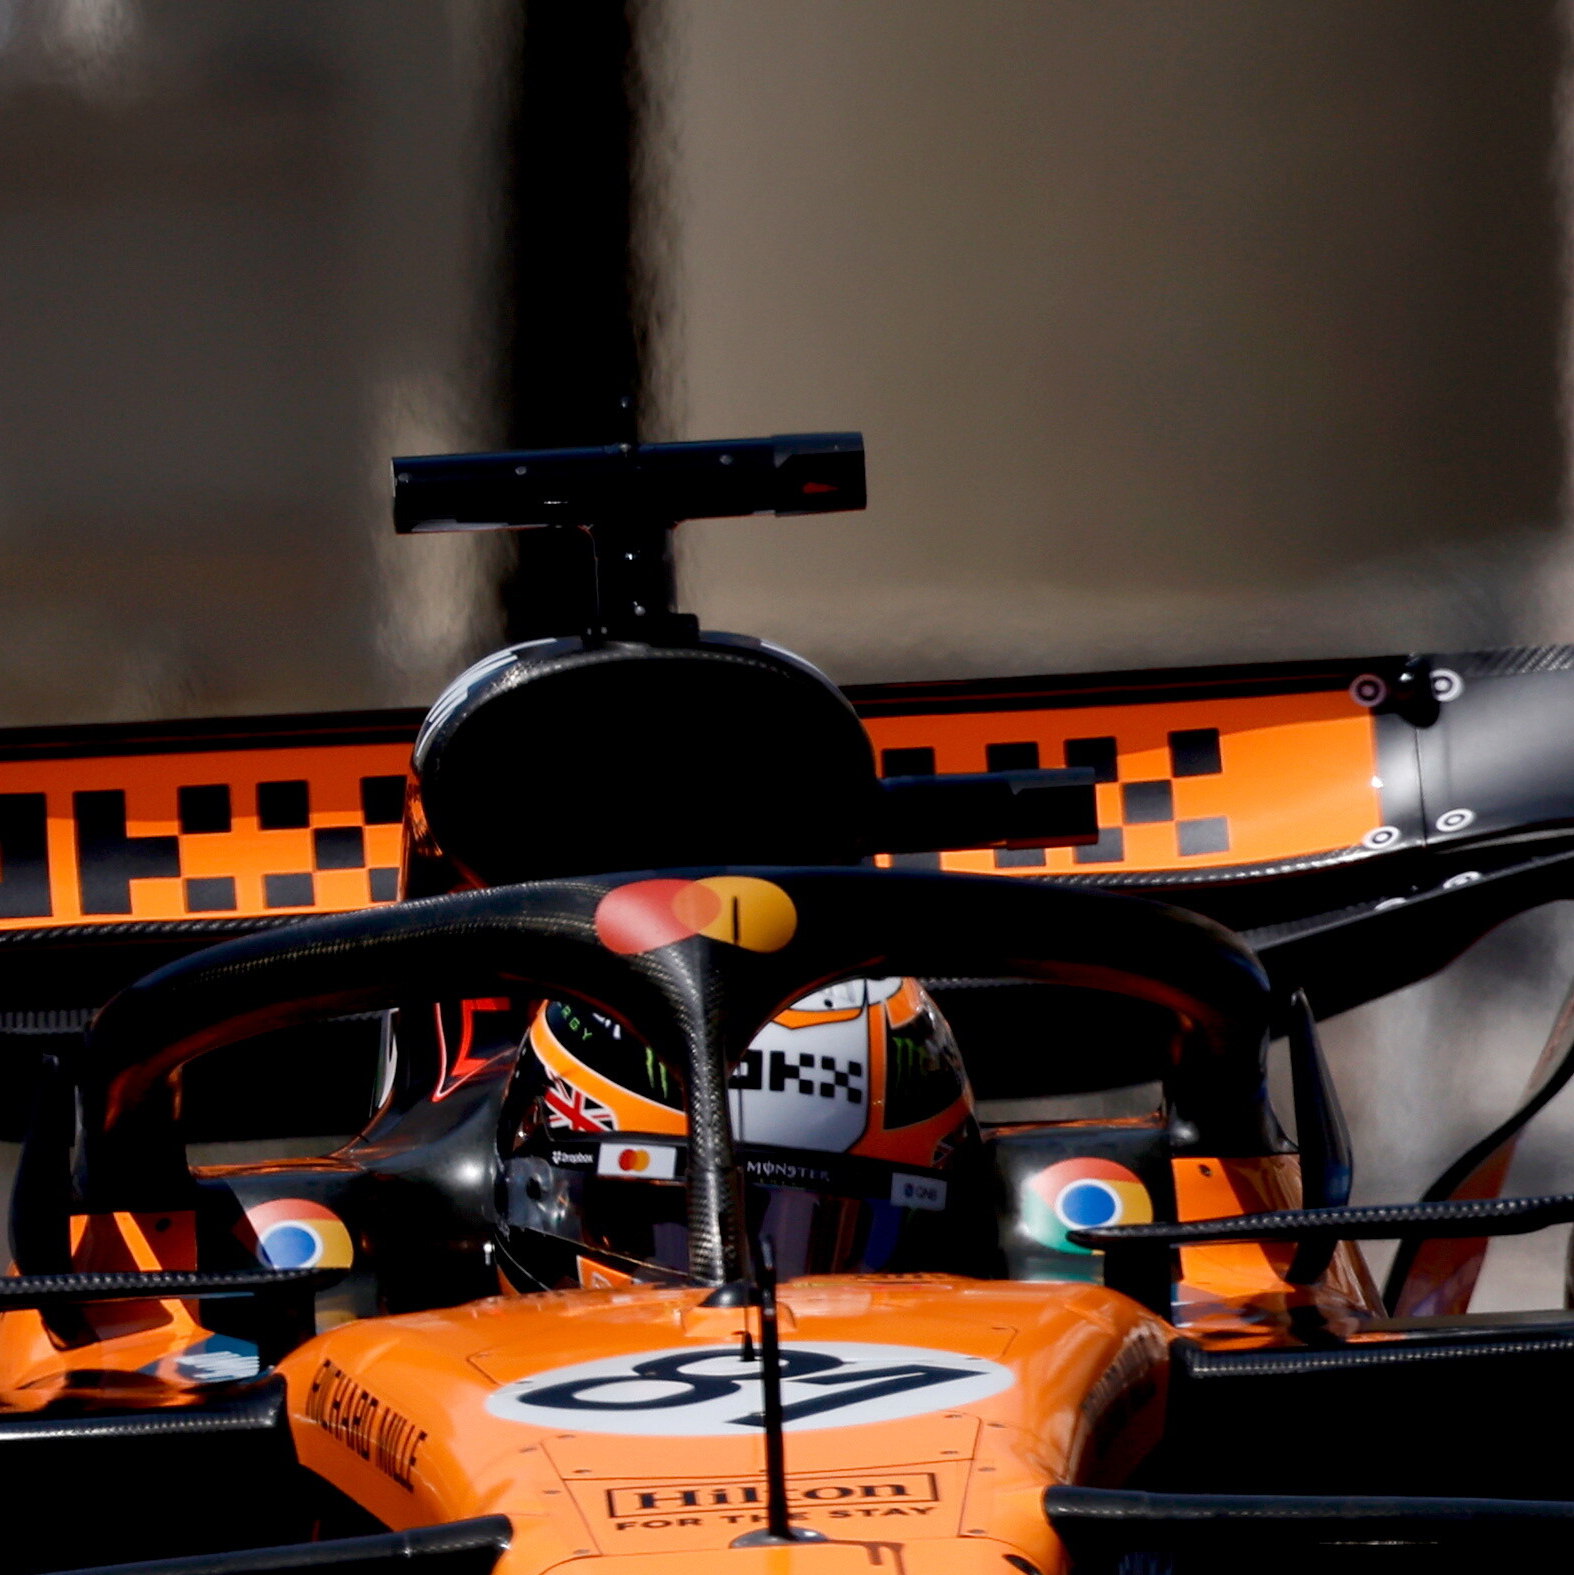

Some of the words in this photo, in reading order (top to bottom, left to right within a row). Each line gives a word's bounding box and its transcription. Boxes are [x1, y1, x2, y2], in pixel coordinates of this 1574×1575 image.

[306, 1359, 380, 1461] RICHARD
[376, 1407, 427, 1493] MILLE
[518, 1347, 990, 1427] 81
[615, 1517, 702, 1531] FOR
[828, 1506, 936, 1519] STAY
